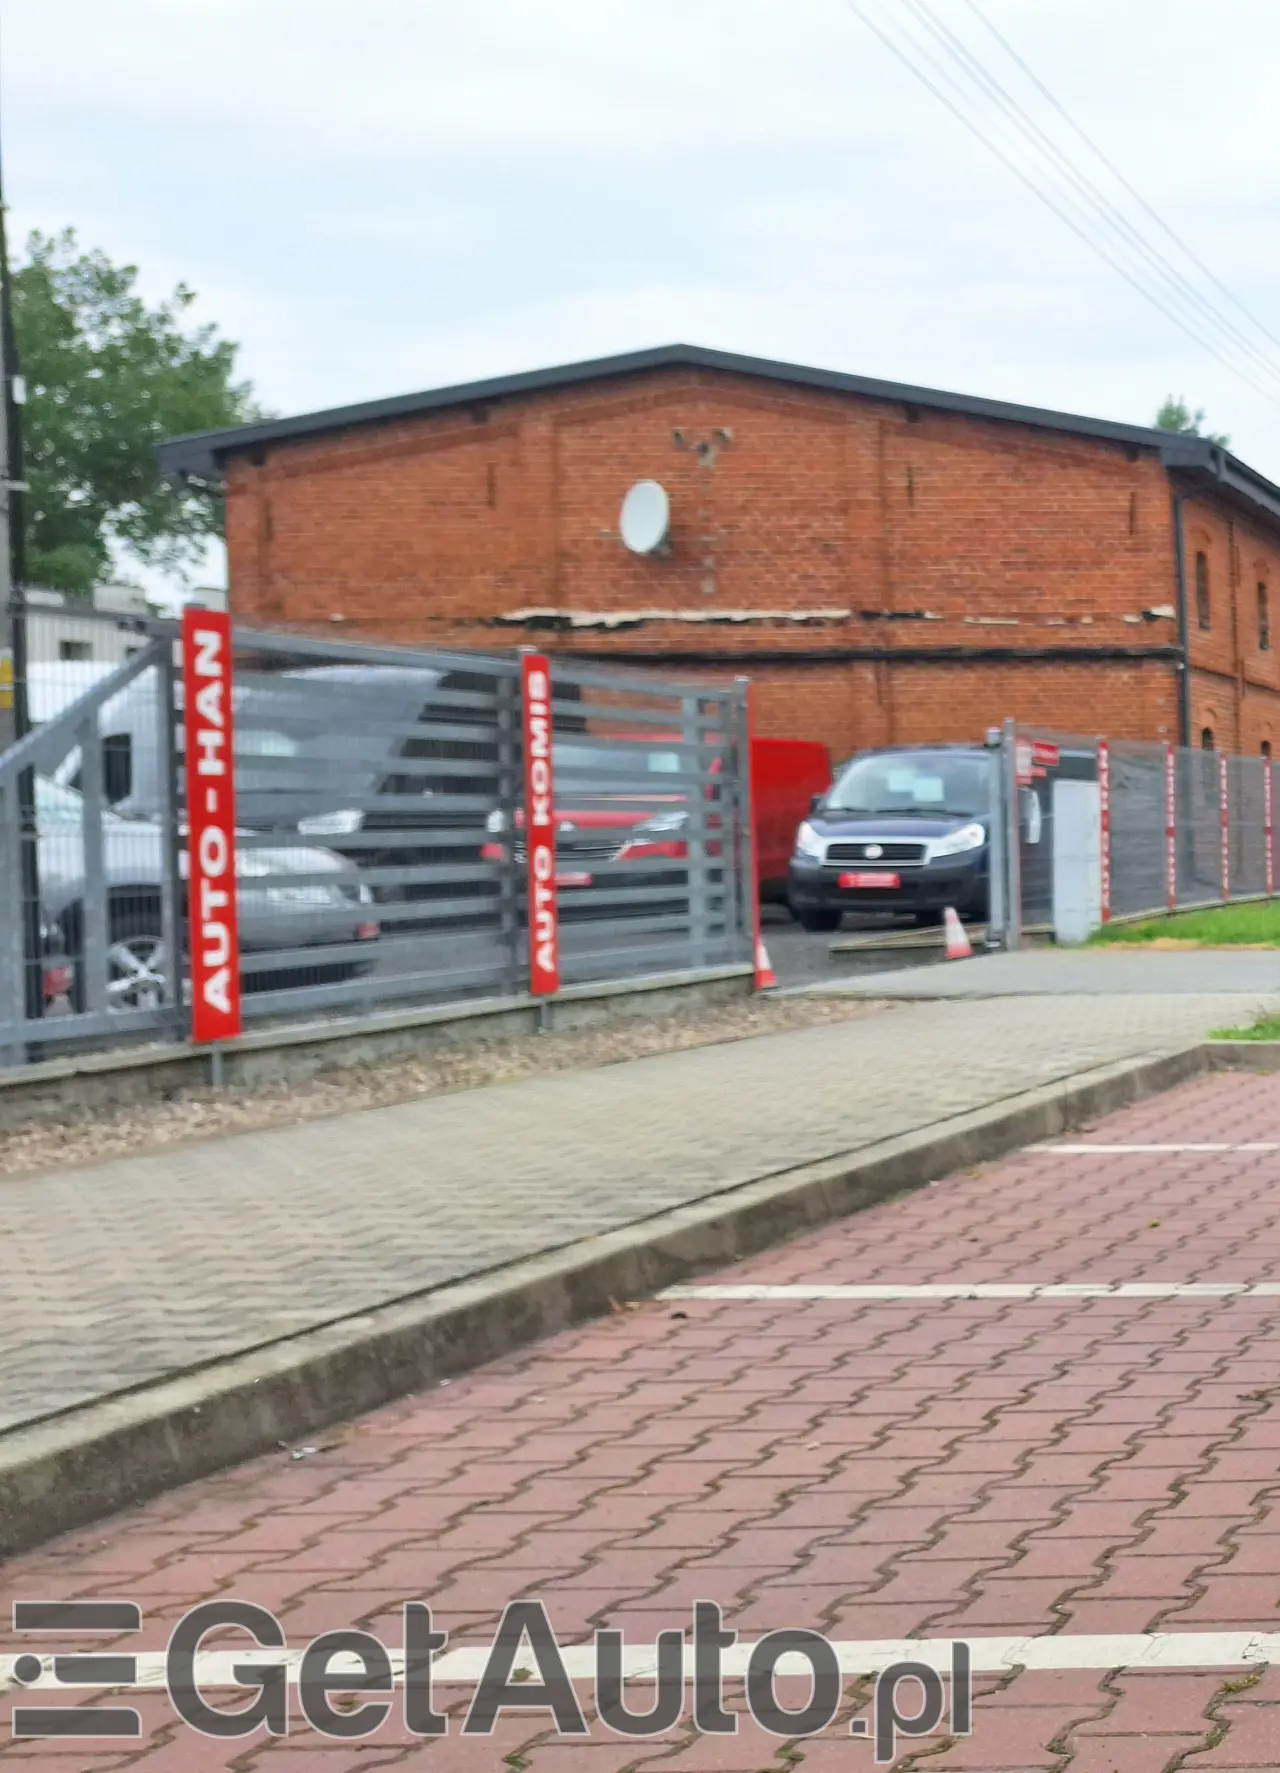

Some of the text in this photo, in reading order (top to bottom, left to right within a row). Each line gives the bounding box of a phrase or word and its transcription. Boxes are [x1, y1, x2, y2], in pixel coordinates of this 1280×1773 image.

[193, 629, 226, 776] HAN
[528, 670, 556, 972] AUTO KOMIS
[200, 825, 232, 1014] AUTO
